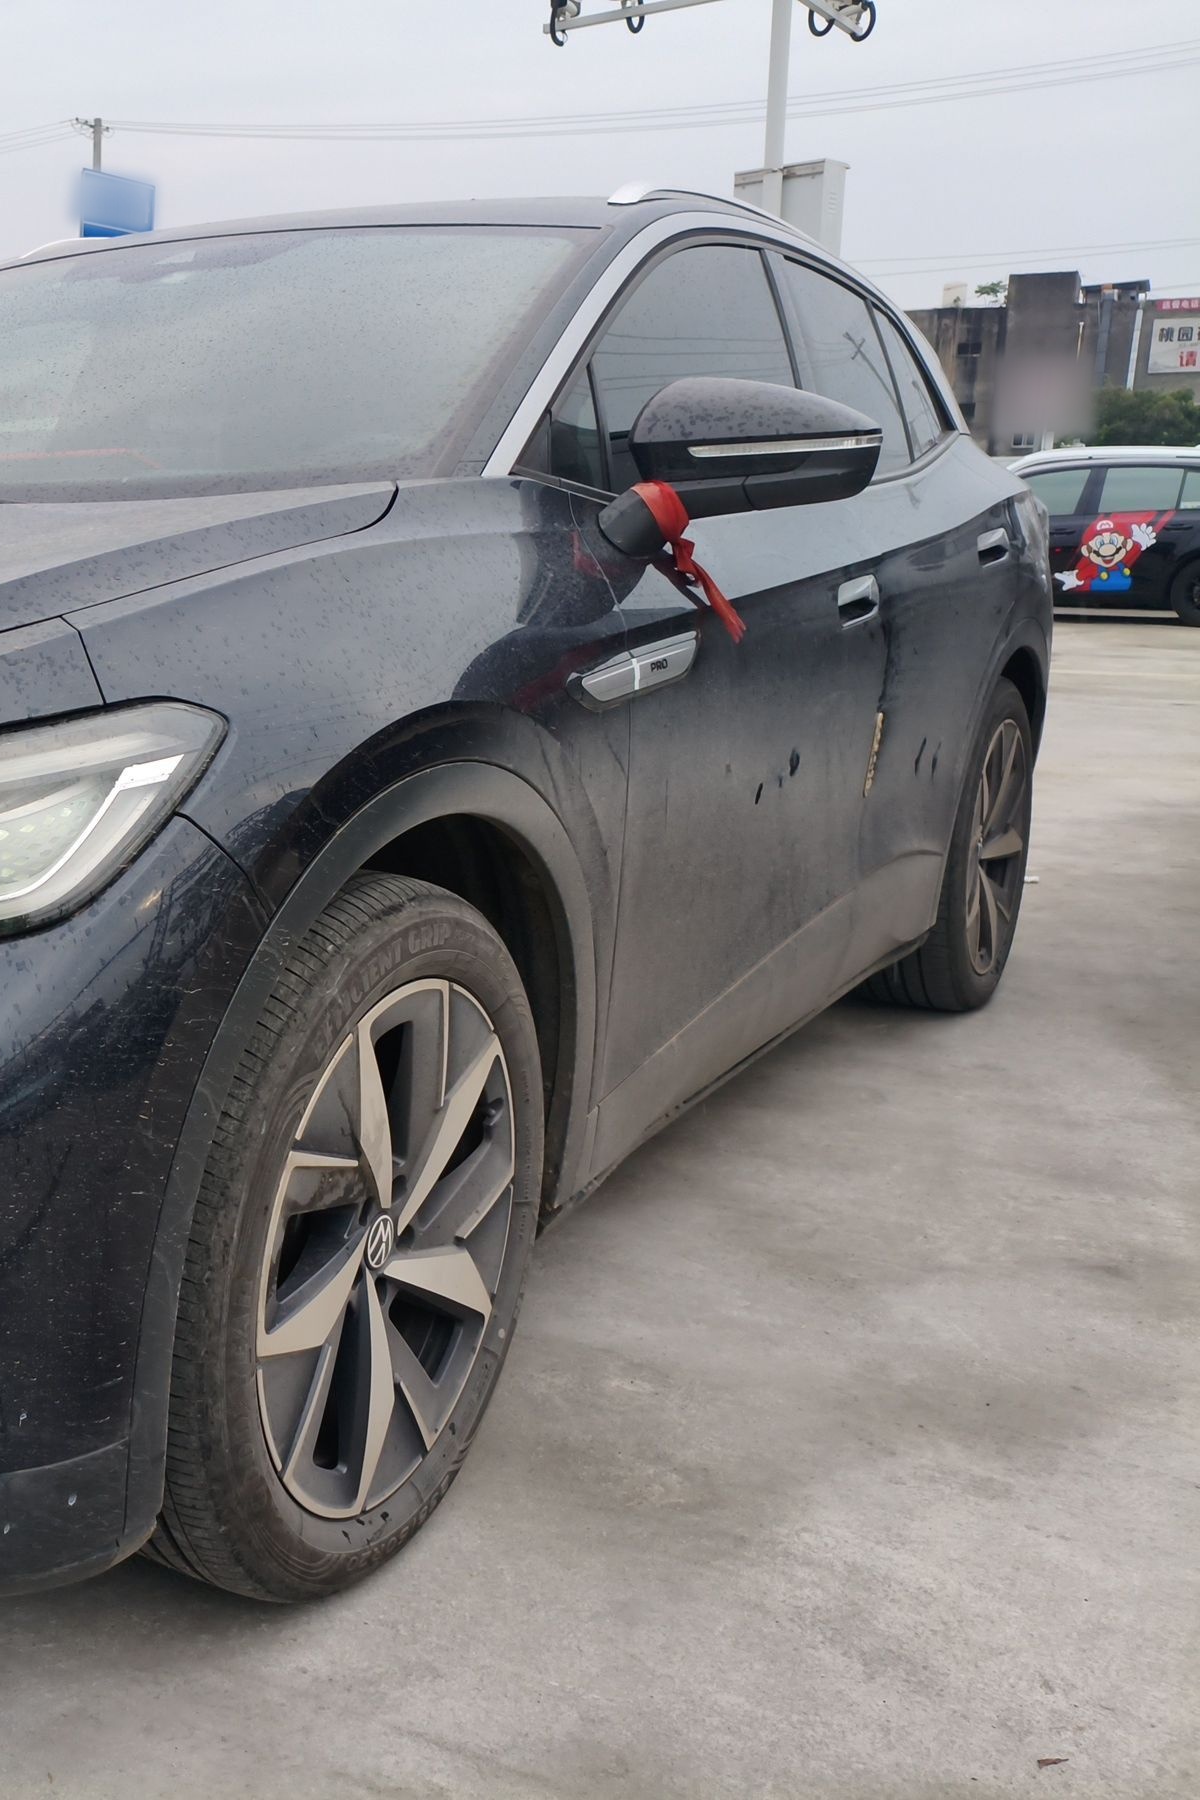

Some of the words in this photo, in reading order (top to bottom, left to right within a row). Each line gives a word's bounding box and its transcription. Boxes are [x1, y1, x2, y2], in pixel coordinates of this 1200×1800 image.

[1159, 326, 1200, 342] 桃园
[650, 658, 668, 672] PRO
[408, 921, 453, 956] GRIP
